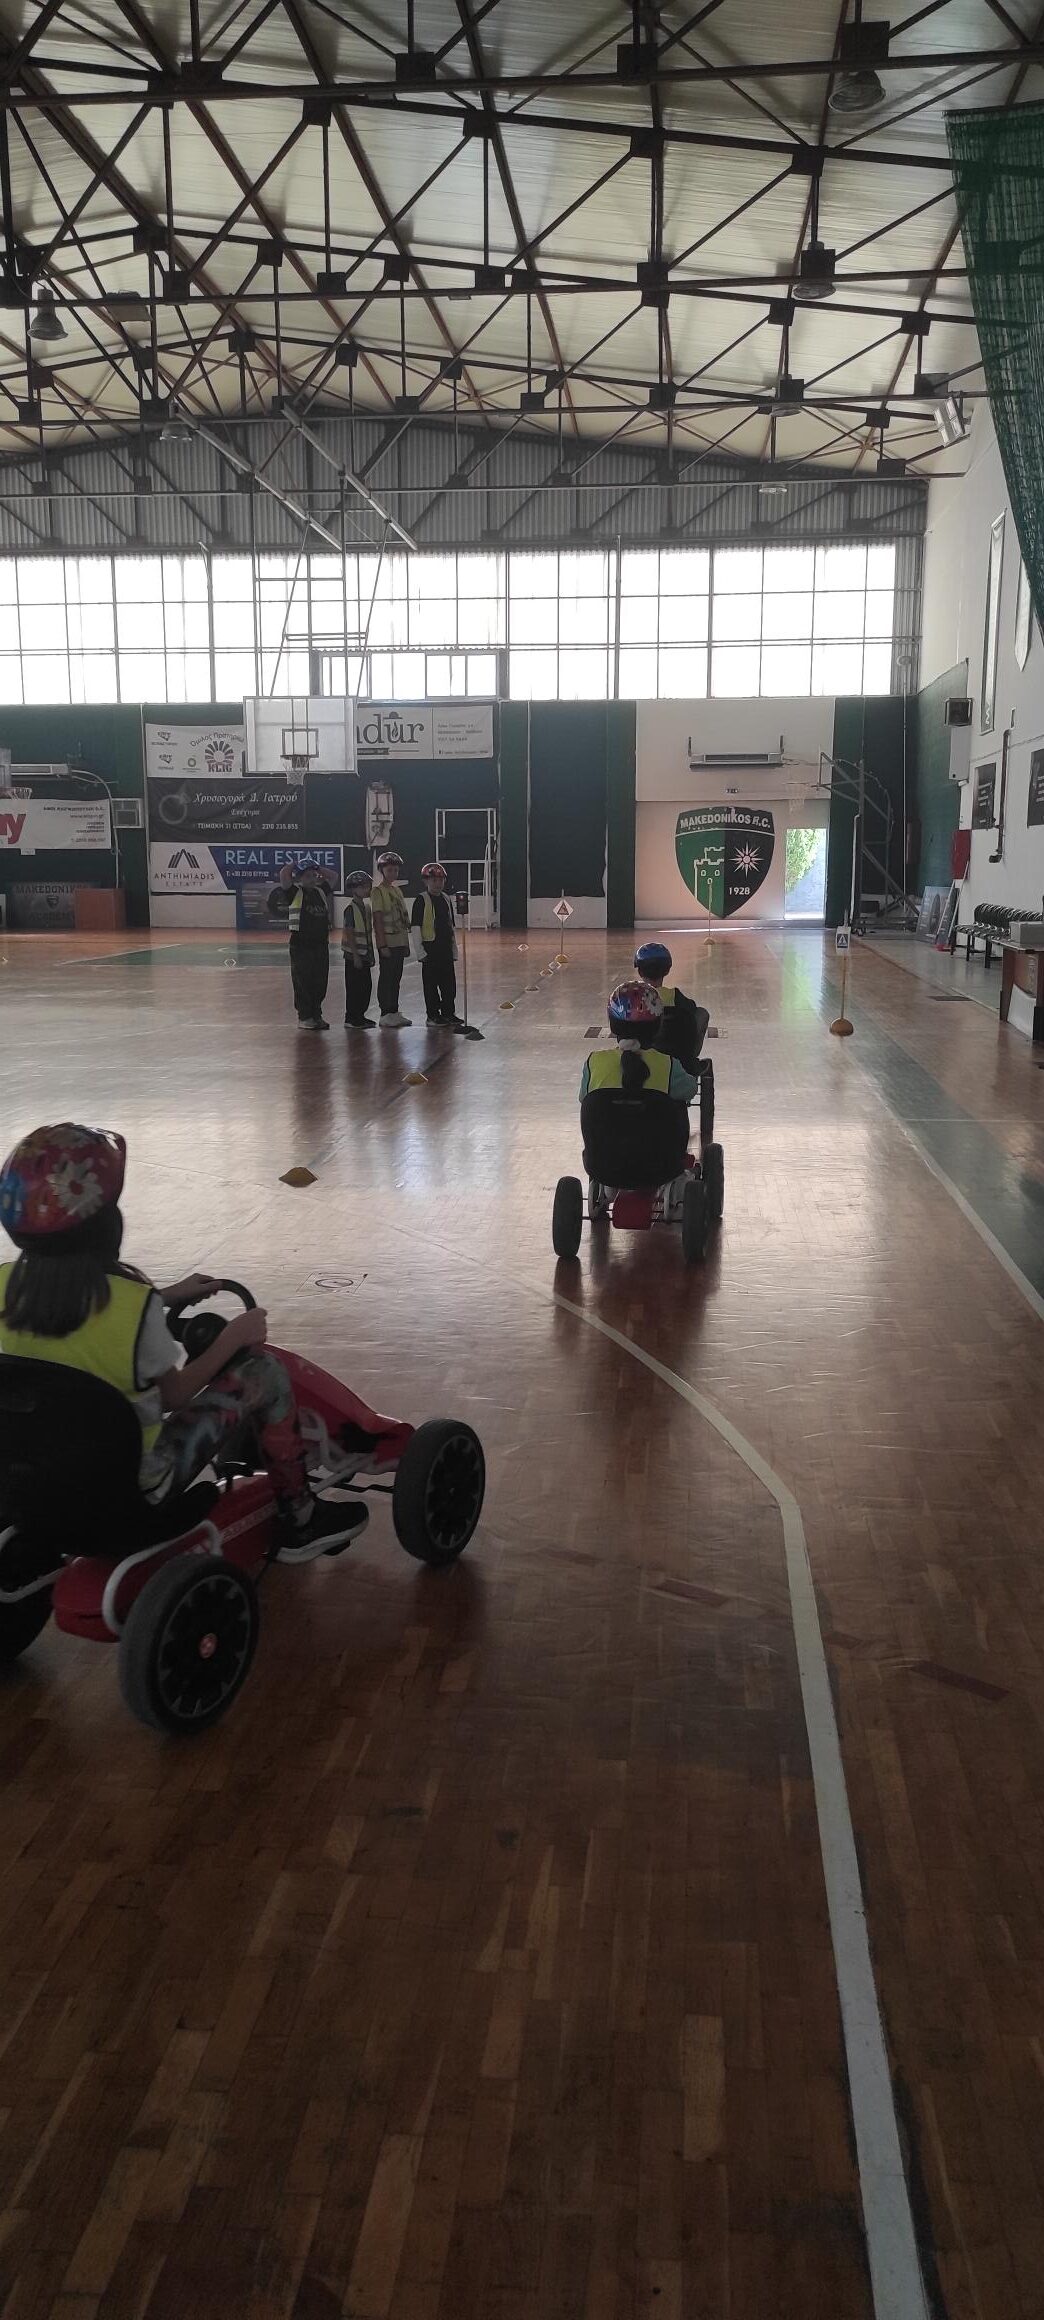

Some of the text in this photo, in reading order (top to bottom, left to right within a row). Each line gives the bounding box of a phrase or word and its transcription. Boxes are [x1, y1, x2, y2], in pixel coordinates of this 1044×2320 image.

[680, 813, 751, 829] MAKEDONIKOS
[225, 849, 335, 866] REAL ESTATE
[154, 872, 215, 880] ANTHIMIADIS
[728, 886, 751, 896] 1928
